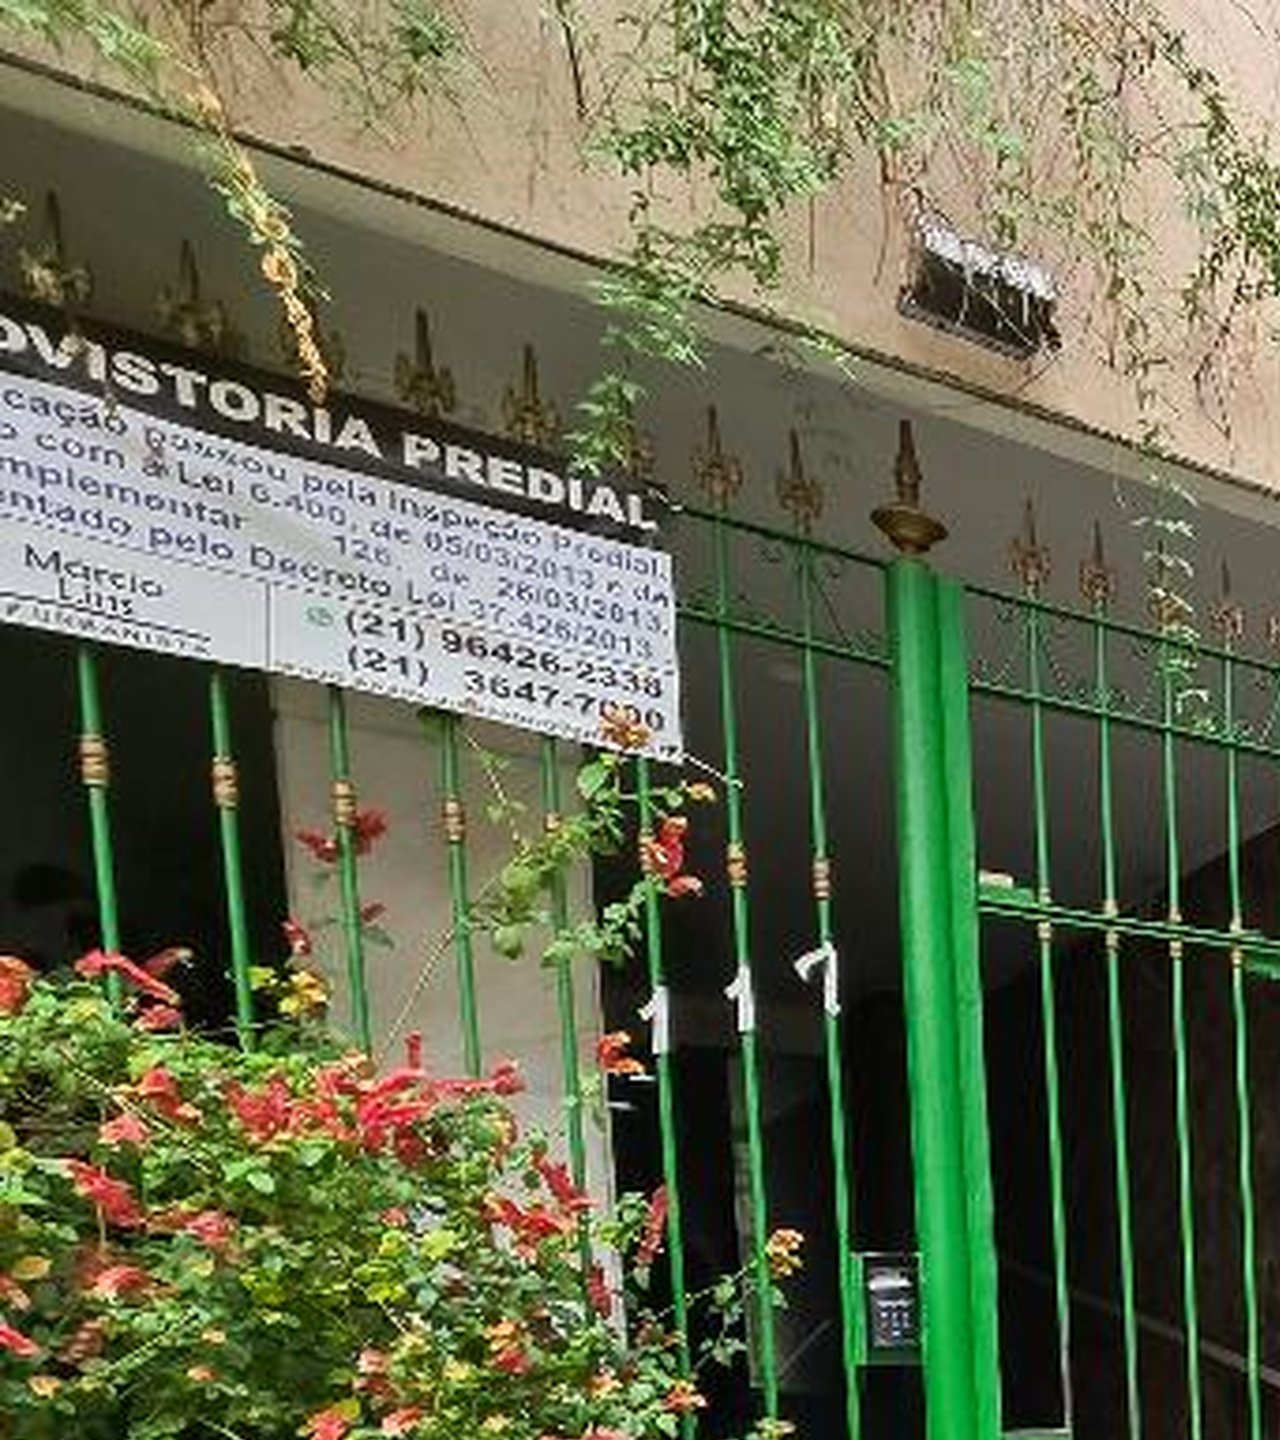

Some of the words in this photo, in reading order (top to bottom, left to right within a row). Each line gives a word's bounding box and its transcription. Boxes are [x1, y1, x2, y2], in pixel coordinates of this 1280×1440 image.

[36, 433, 125, 470] com
[178, 460, 235, 495] Lei
[369, 517, 412, 545] de
[302, 474, 376, 507] pela
[402, 431, 658, 532] PREDIAL
[58, 576, 133, 616] Lins
[149, 526, 234, 561] pelo
[251, 543, 392, 598] Decreto
[408, 580, 455, 612] Lei
[430, 561, 469, 586] de
[345, 609, 426, 652] (21)
[440, 629, 663, 699] 96426-2338
[347, 645, 429, 688] (21)
